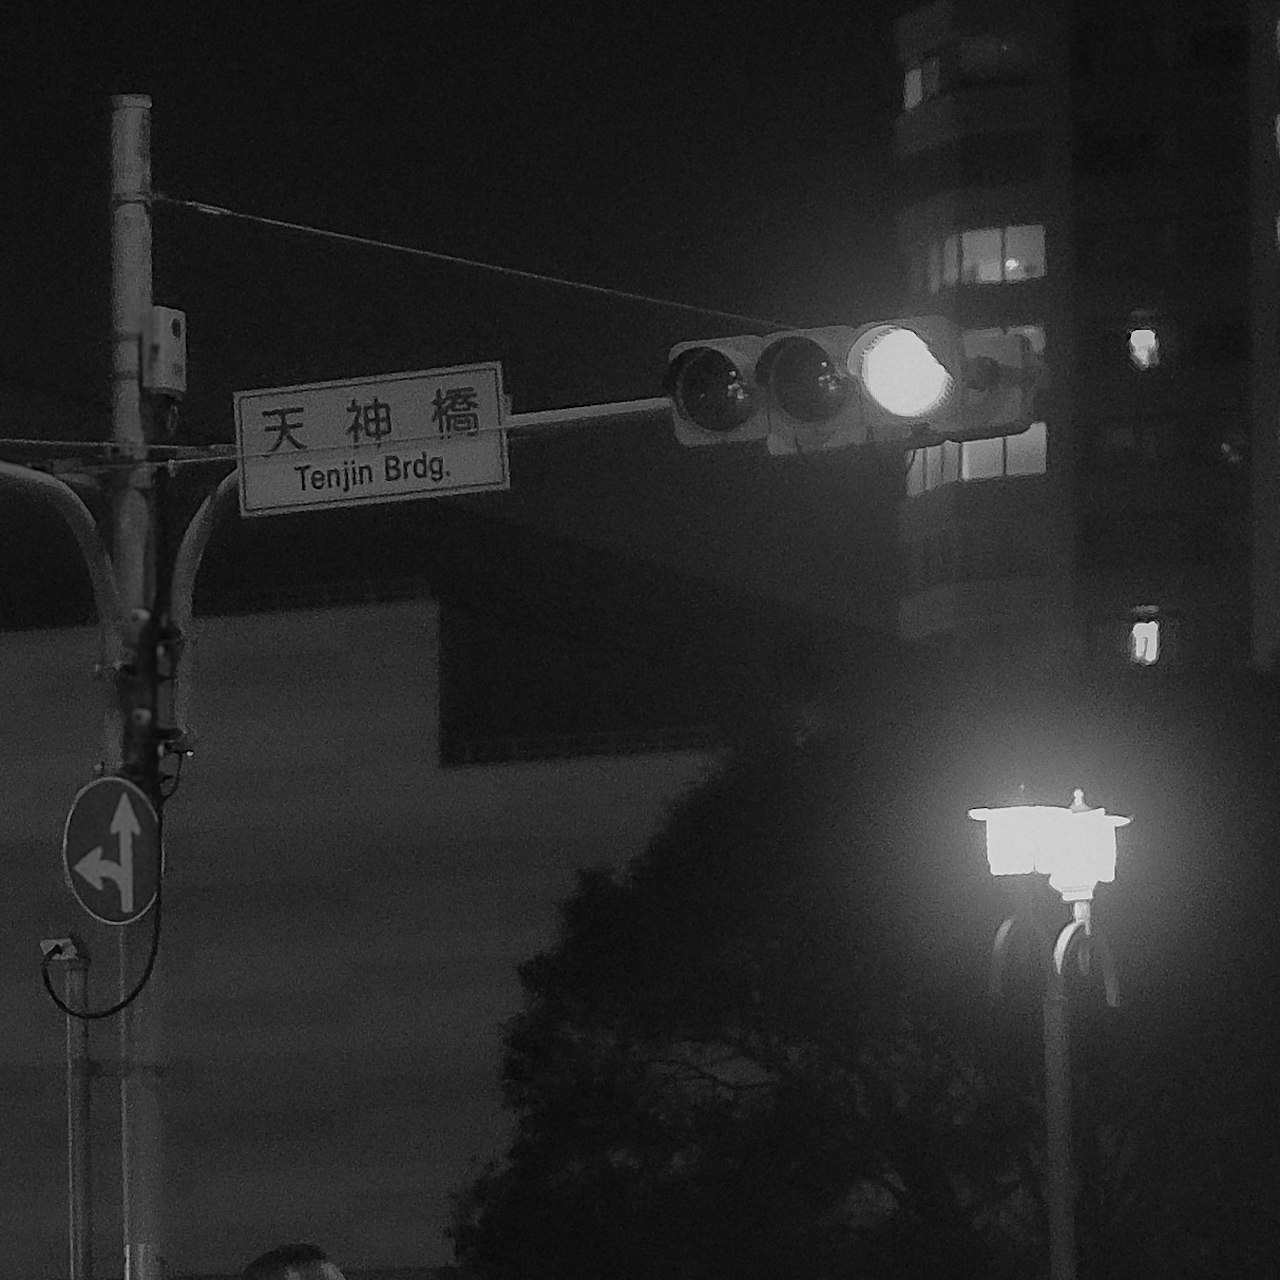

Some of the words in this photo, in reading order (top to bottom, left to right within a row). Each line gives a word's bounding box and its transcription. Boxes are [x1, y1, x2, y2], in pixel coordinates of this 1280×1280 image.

[261, 386, 480, 452] 天神橋
[294, 461, 374, 492] Tenjin
[384, 453, 451, 482] Brdg.
